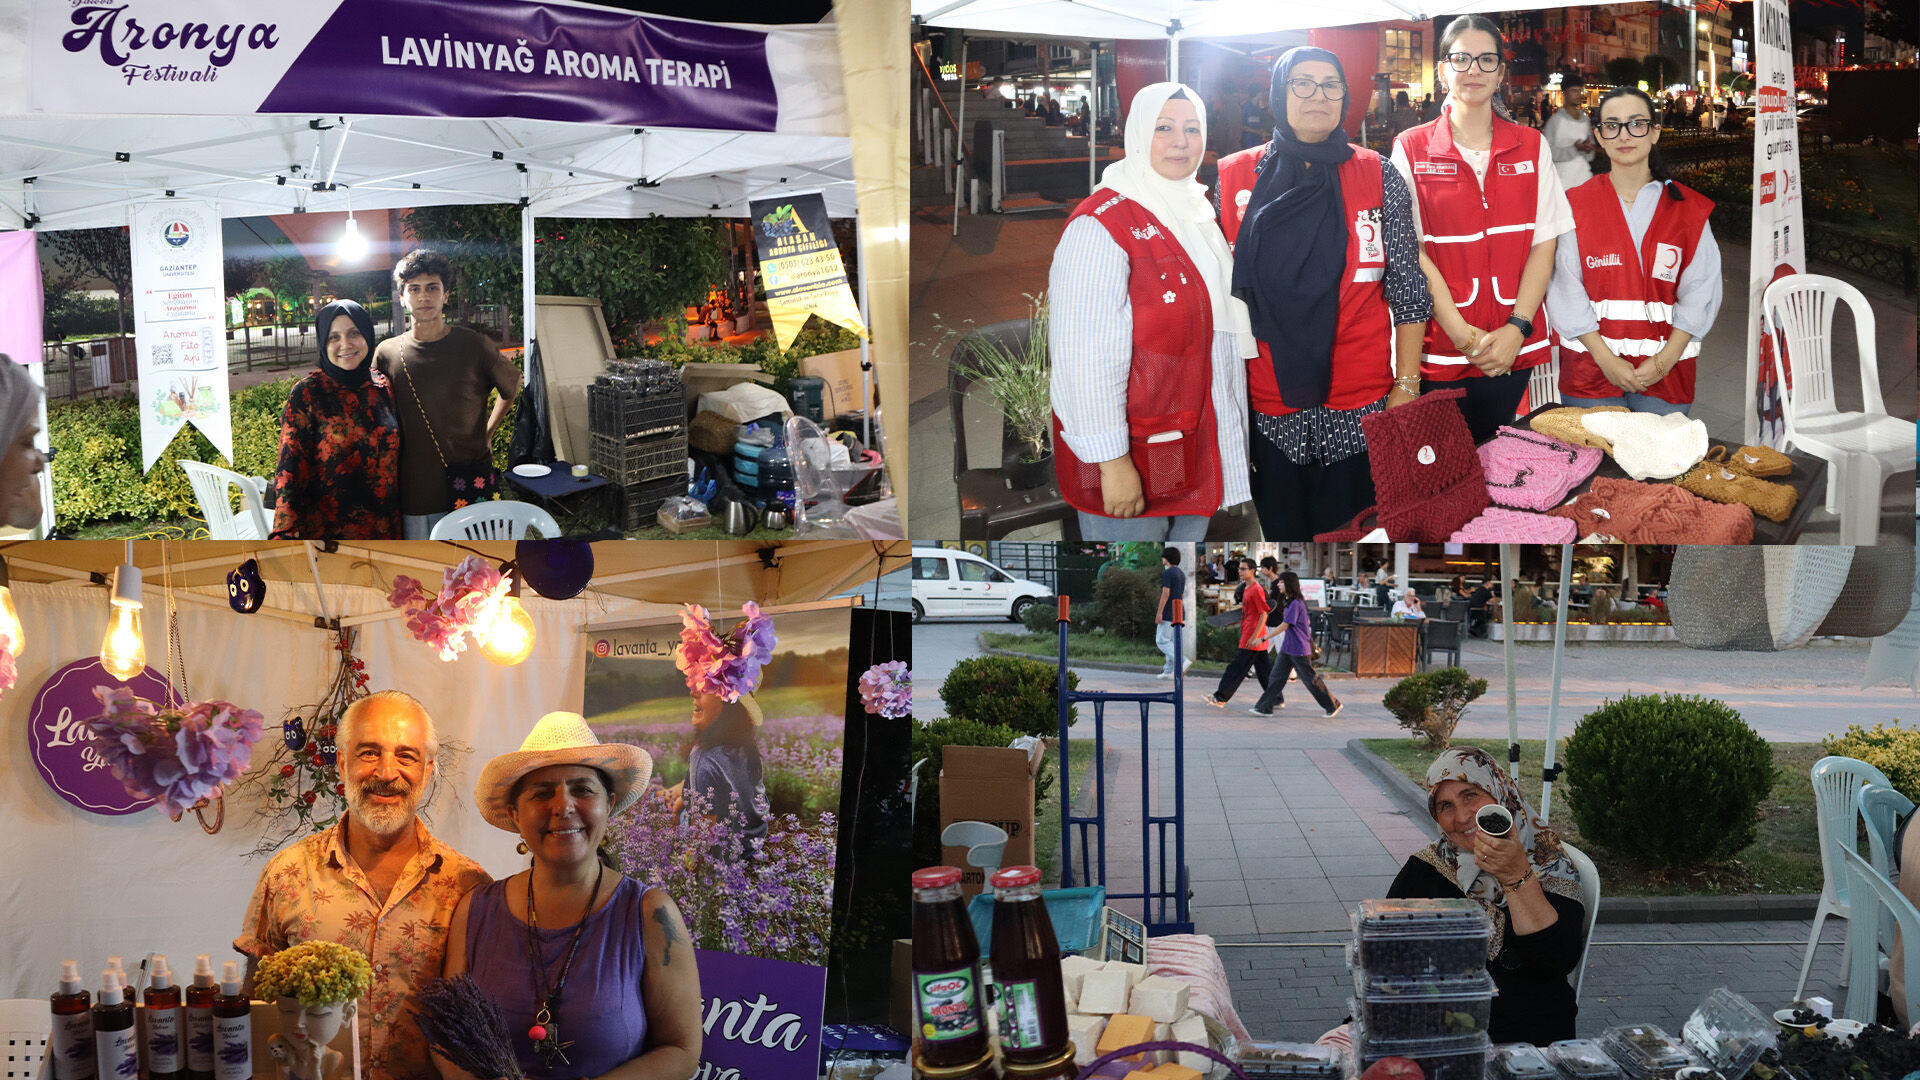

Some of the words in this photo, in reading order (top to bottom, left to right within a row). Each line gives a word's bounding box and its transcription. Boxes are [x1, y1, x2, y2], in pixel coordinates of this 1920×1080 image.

[62, 4, 280, 68] Aronya
[121, 63, 218, 86] Festivali
[381, 32, 534, 74] LAVİNYAĞ
[544, 49, 641, 84] AROMA
[645, 57, 732, 90] TERAPİ
[163, 330, 198, 338] Aroma
